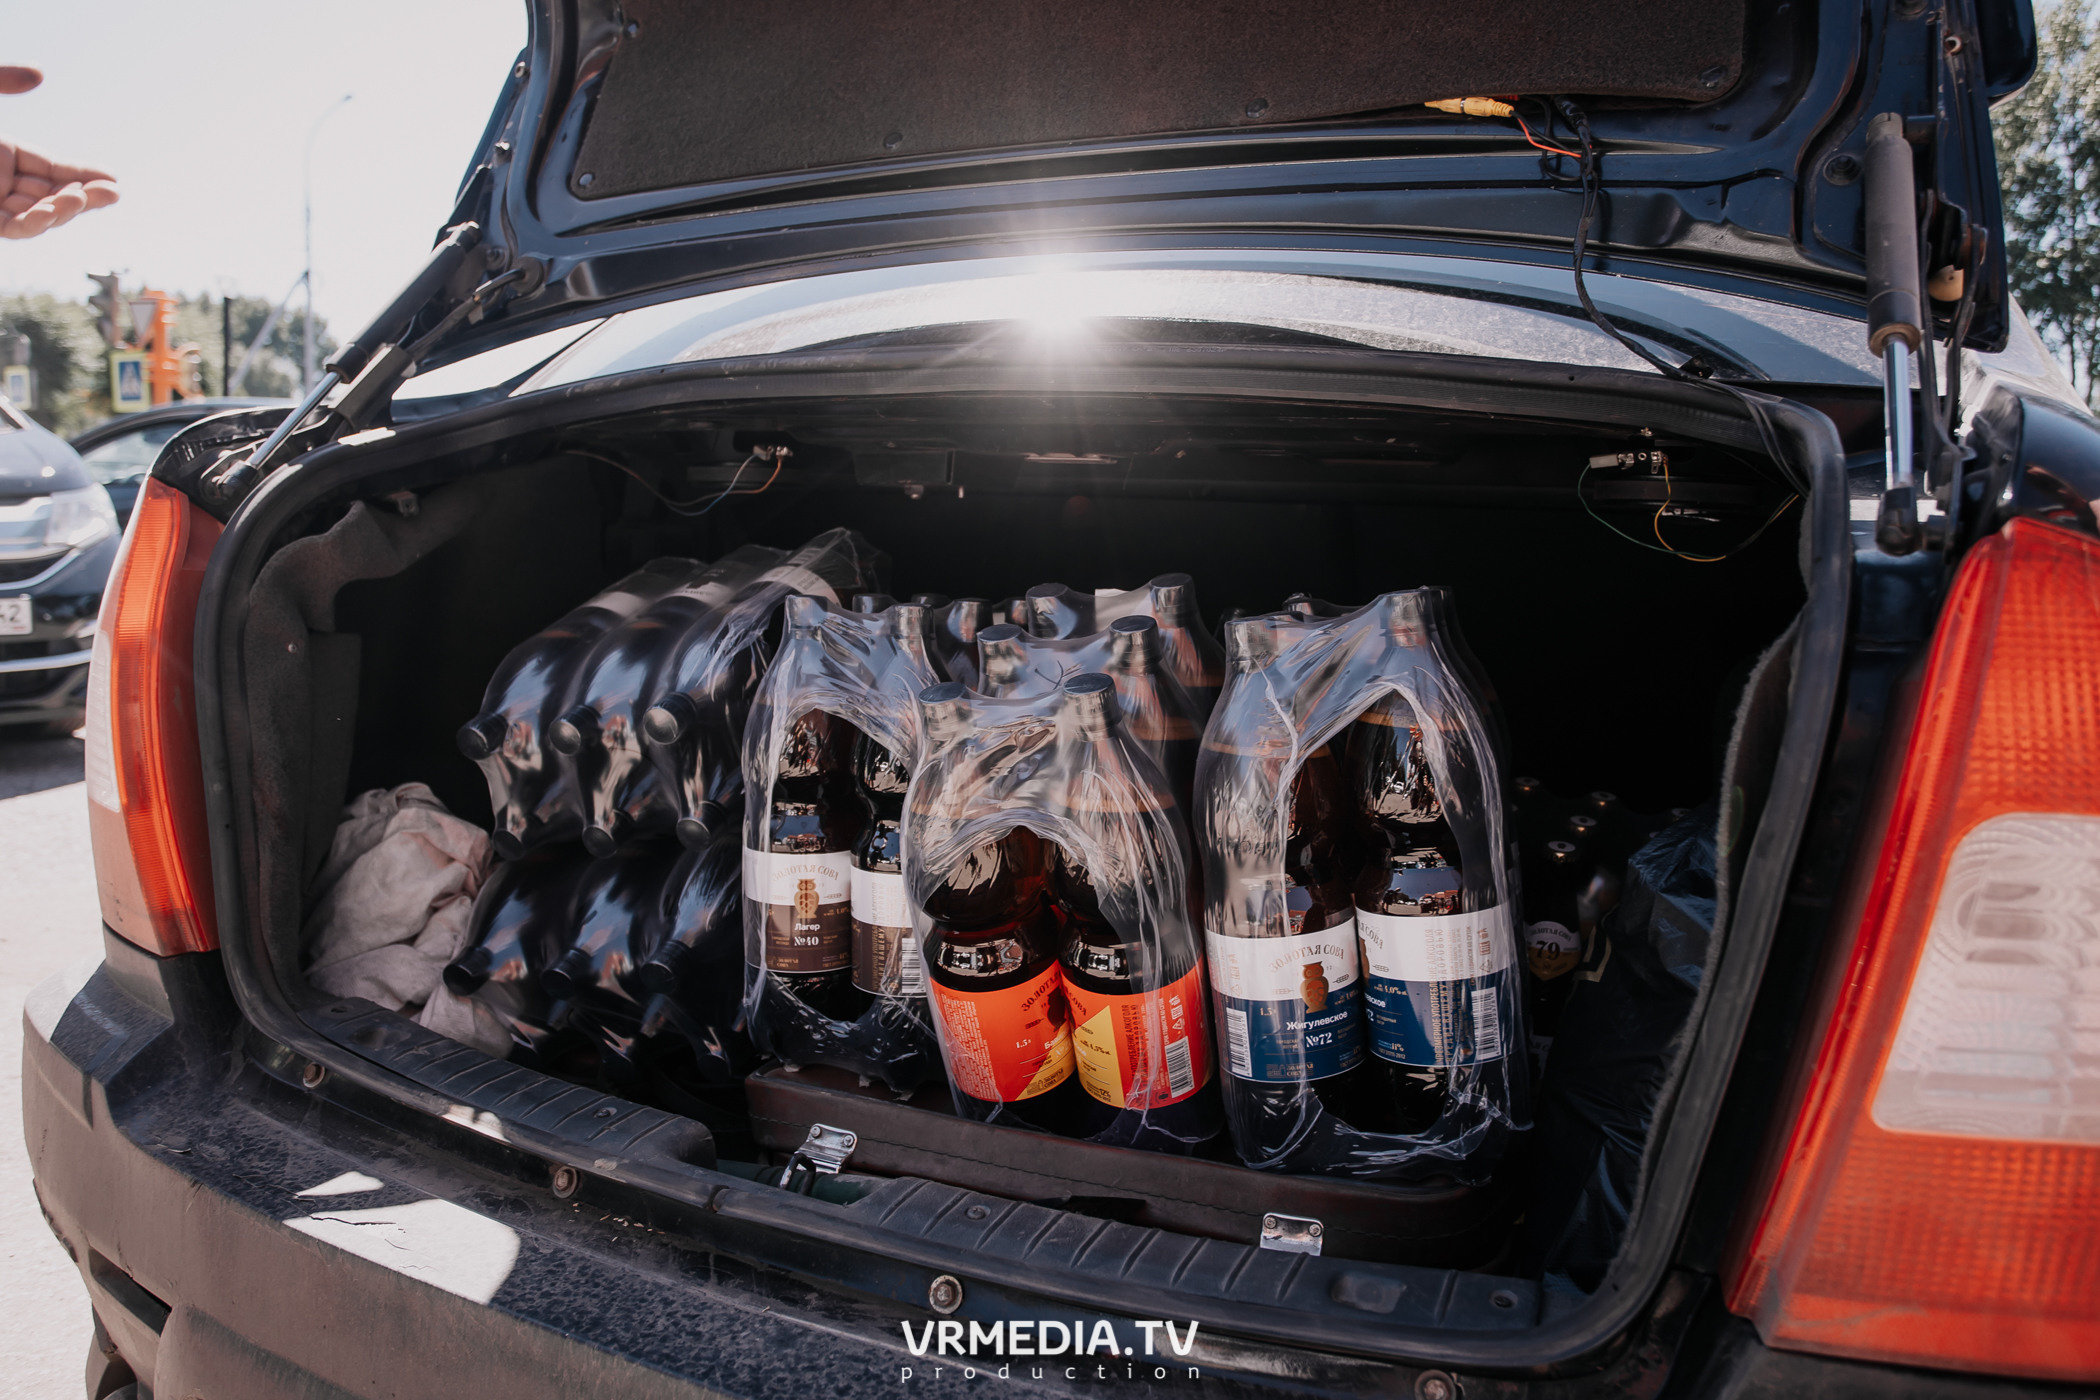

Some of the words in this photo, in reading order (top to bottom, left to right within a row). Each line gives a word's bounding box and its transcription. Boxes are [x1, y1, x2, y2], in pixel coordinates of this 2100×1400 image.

[772, 864, 816, 882] ЗОЛОТАЯ
[817, 865, 840, 881] СОВА
[794, 922, 821, 933] Лагер
[794, 936, 820, 947] №40
[1365, 926, 1383, 949] СОВА
[1268, 944, 1321, 974] ЗОЛОТАЯ
[1323, 944, 1345, 960] СОВА
[1425, 929, 1437, 964] АЛКОГОЛЯ
[1435, 929, 1448, 981] ЗДОРОВЬЮ
[1536, 939, 1560, 961] 79
[1428, 966, 1441, 1017] УПОТРЕБЛЕНИЕ
[1440, 985, 1450, 1023] ВАШЕМУ
[1121, 1004, 1132, 1033] АЛКОГОЛЯ
[1286, 1011, 1348, 1031] Жигулевское
[1306, 1032, 1333, 1048] №72
[1432, 1019, 1444, 1062] ЧРЕЗМЕРНОЕ
[1443, 1026, 1454, 1062] ВРЕДИТ
